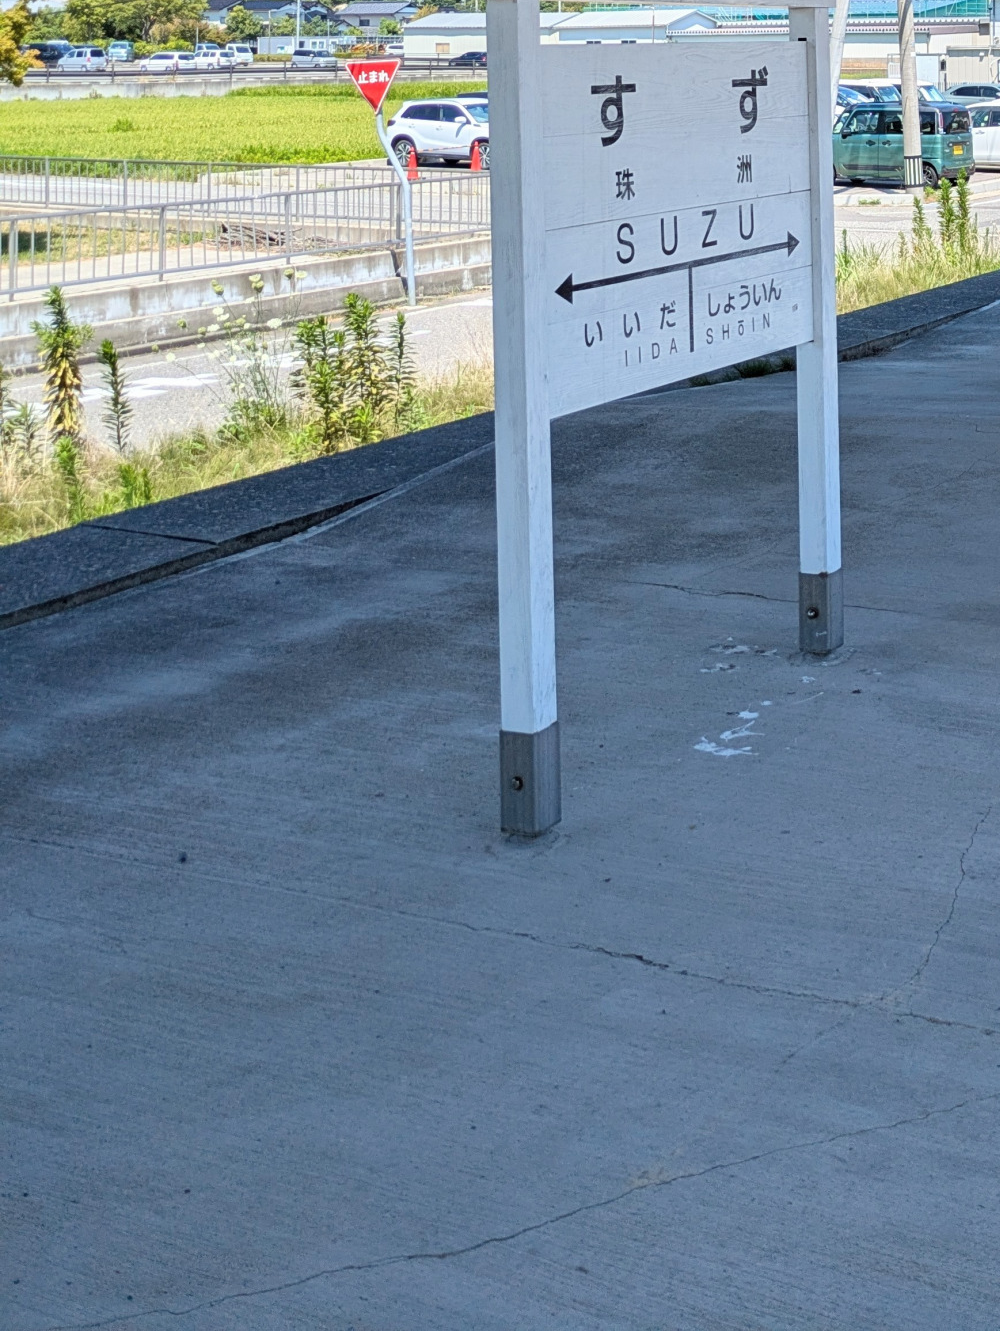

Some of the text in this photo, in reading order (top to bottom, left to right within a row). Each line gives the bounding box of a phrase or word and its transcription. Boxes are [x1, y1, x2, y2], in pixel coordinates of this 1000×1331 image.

[358, 70, 390, 84] 止まれ
[591, 66, 769, 147] すず
[615, 154, 752, 201] 珠洲
[616, 203, 755, 264] SUZU
[708, 278, 782, 317] しょういん
[584, 299, 677, 348] いいだ
[625, 337, 679, 367] IIDA
